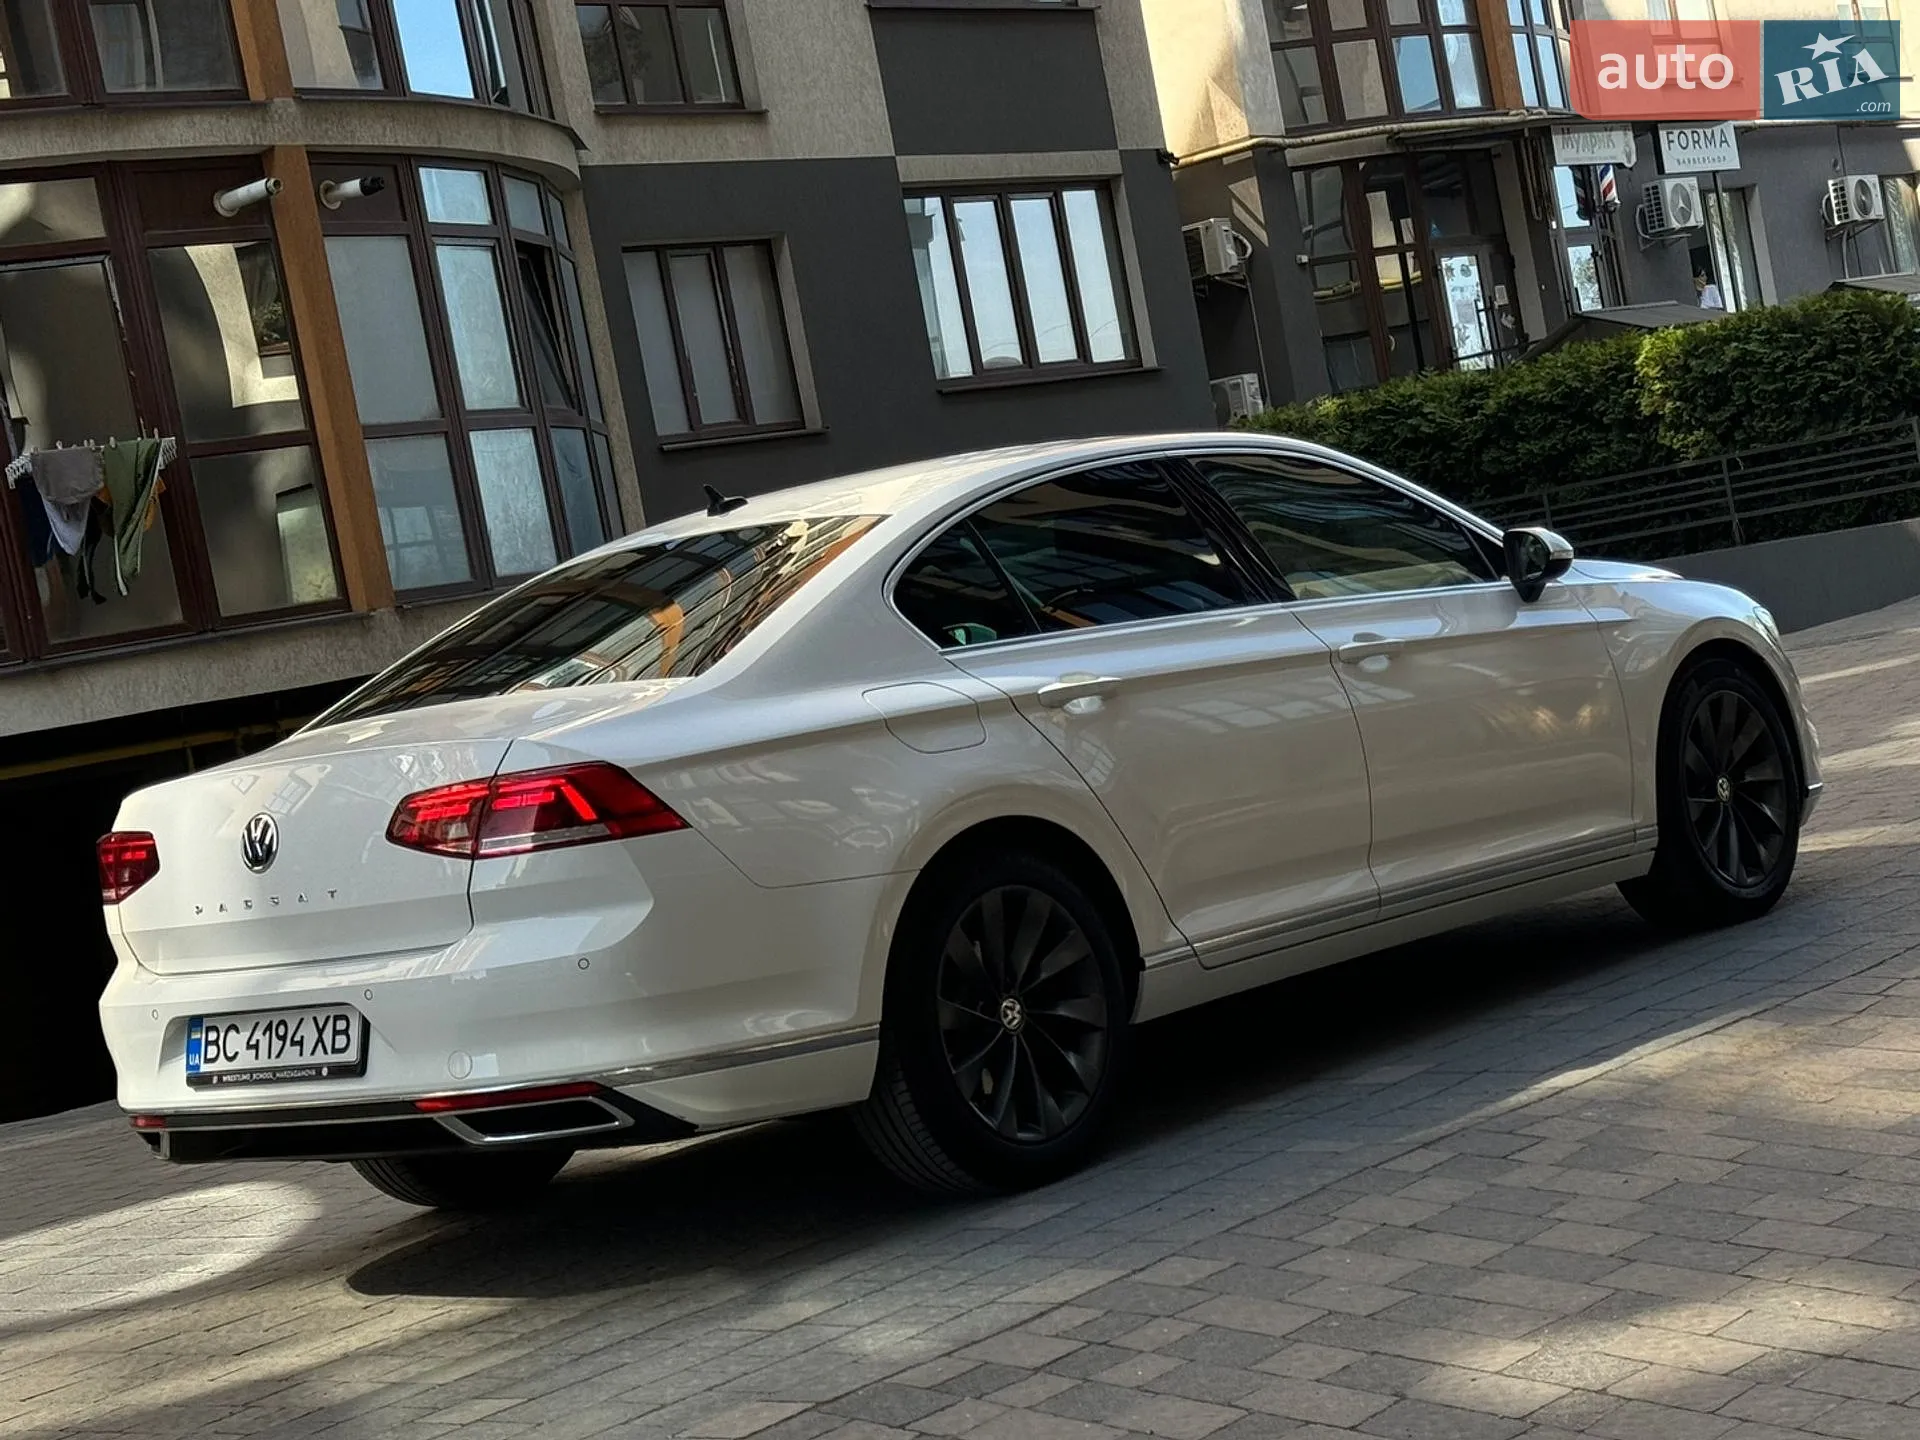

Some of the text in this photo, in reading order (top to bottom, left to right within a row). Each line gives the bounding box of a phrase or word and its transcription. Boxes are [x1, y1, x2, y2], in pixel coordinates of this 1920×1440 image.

[1665, 128, 1731, 151] FORMA
[203, 1014, 351, 1064] BC 4194 XB
[188, 1054, 200, 1066] UA
